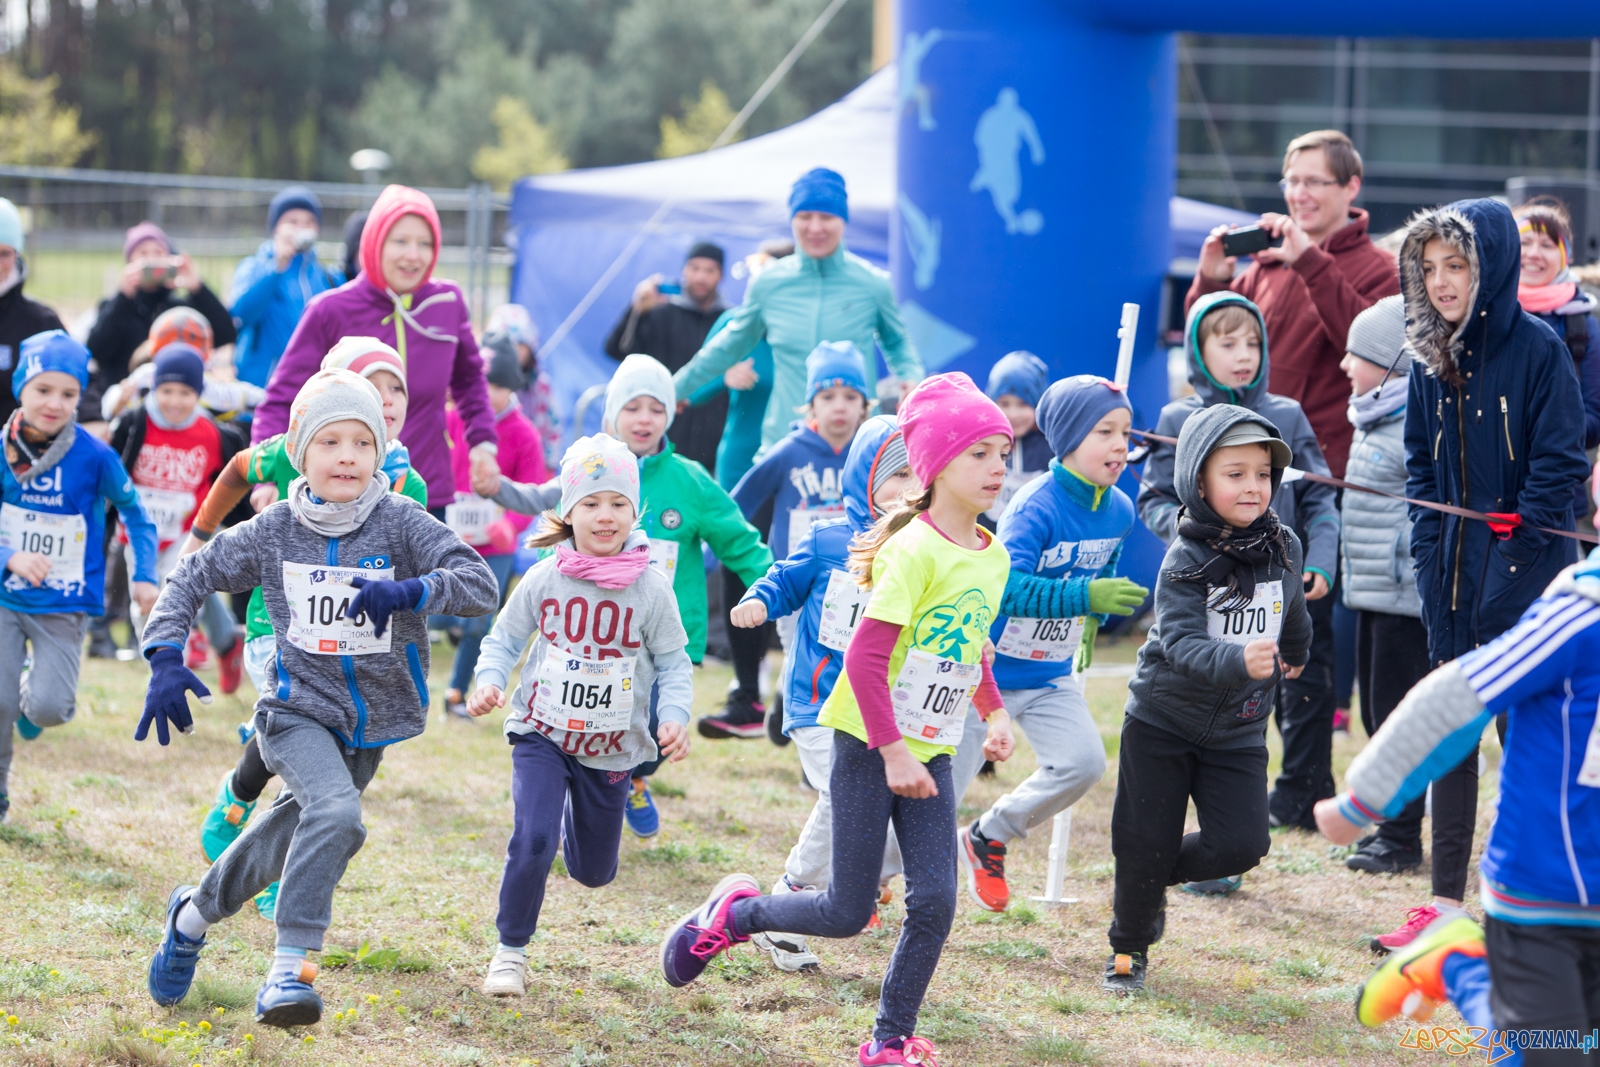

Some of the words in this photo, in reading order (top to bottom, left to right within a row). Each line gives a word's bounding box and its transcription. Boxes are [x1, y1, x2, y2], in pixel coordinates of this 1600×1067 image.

[21, 531, 65, 557] 1091
[540, 596, 641, 648] COOL
[834, 628, 850, 638] 5KM
[1031, 619, 1072, 641] 1053
[1223, 607, 1266, 635] 1070
[351, 630, 373, 639] 10KM
[562, 680, 613, 710] 1054
[922, 683, 965, 715] 1067
[550, 705, 564, 715] 5KM
[597, 711, 616, 719] 10KM
[905, 709, 922, 719] 5KM
